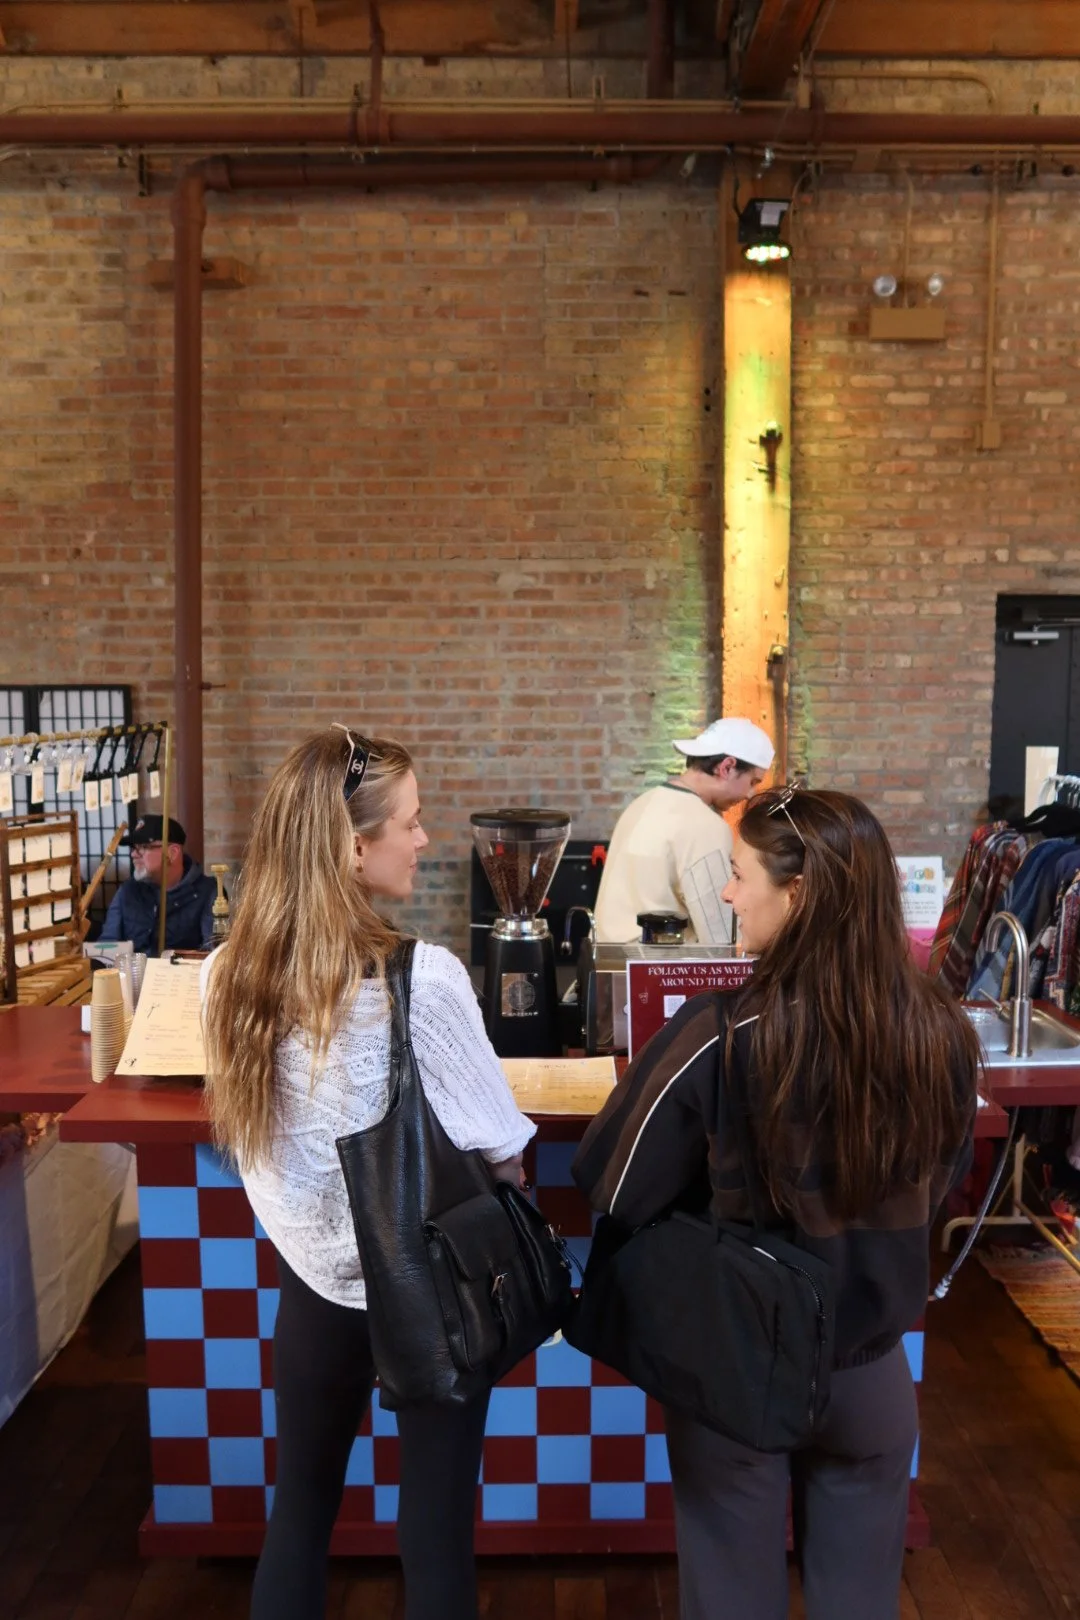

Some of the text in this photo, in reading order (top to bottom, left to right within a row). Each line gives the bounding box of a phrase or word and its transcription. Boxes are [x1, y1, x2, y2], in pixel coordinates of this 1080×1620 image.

[648, 966, 690, 976] FOLLOW
[693, 966, 707, 975] US
[708, 966, 722, 975] AS
[724, 966, 740, 975] WE
[659, 977, 747, 987] AROUND THE CIT
